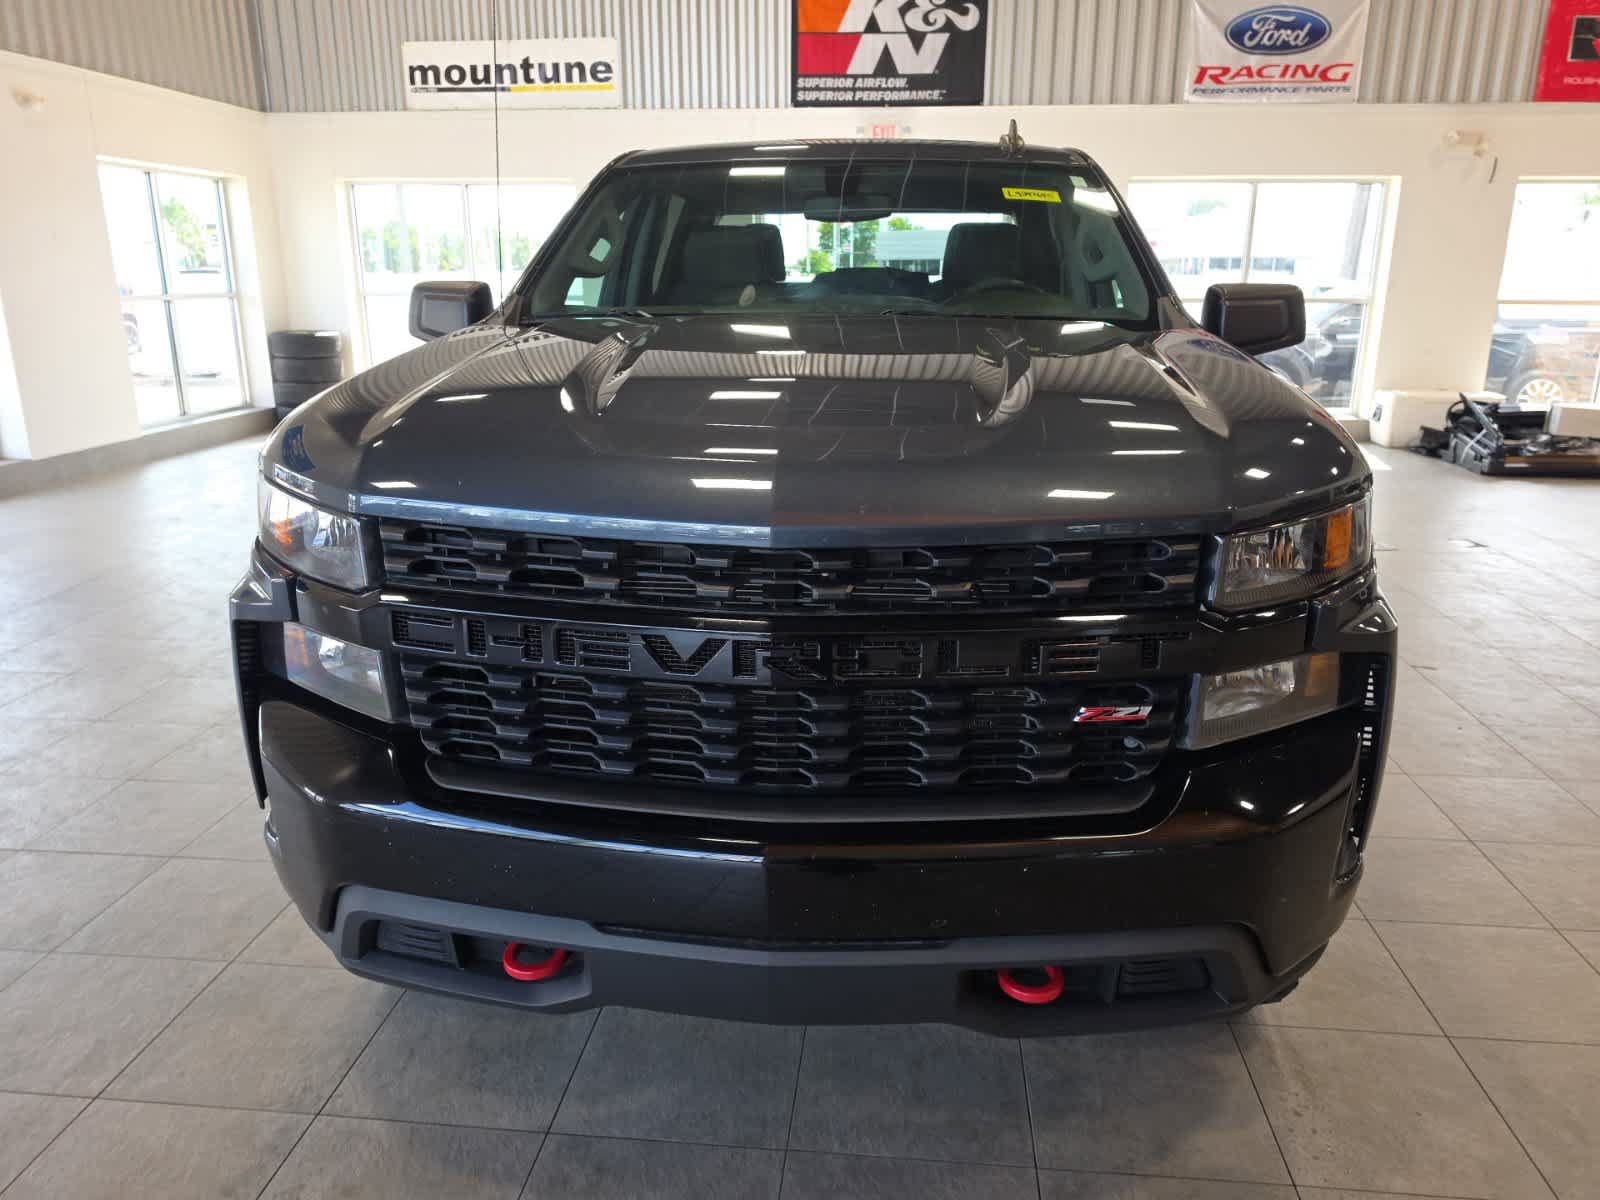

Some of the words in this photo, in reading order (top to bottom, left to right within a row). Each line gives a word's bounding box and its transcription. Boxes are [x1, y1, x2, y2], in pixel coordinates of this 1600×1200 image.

[1243, 14, 1313, 47] Ford
[408, 56, 614, 86] mountune
[1193, 63, 1355, 86] RACING
[796, 77, 854, 89] SUPERIOR
[855, 77, 909, 89] AIRFLOW.
[1192, 86, 1301, 95] PERFORMANCE
[1305, 85, 1352, 94] PARTS
[796, 90, 854, 101] SUPERIOR
[391, 610, 1193, 681] CHEVROLET
